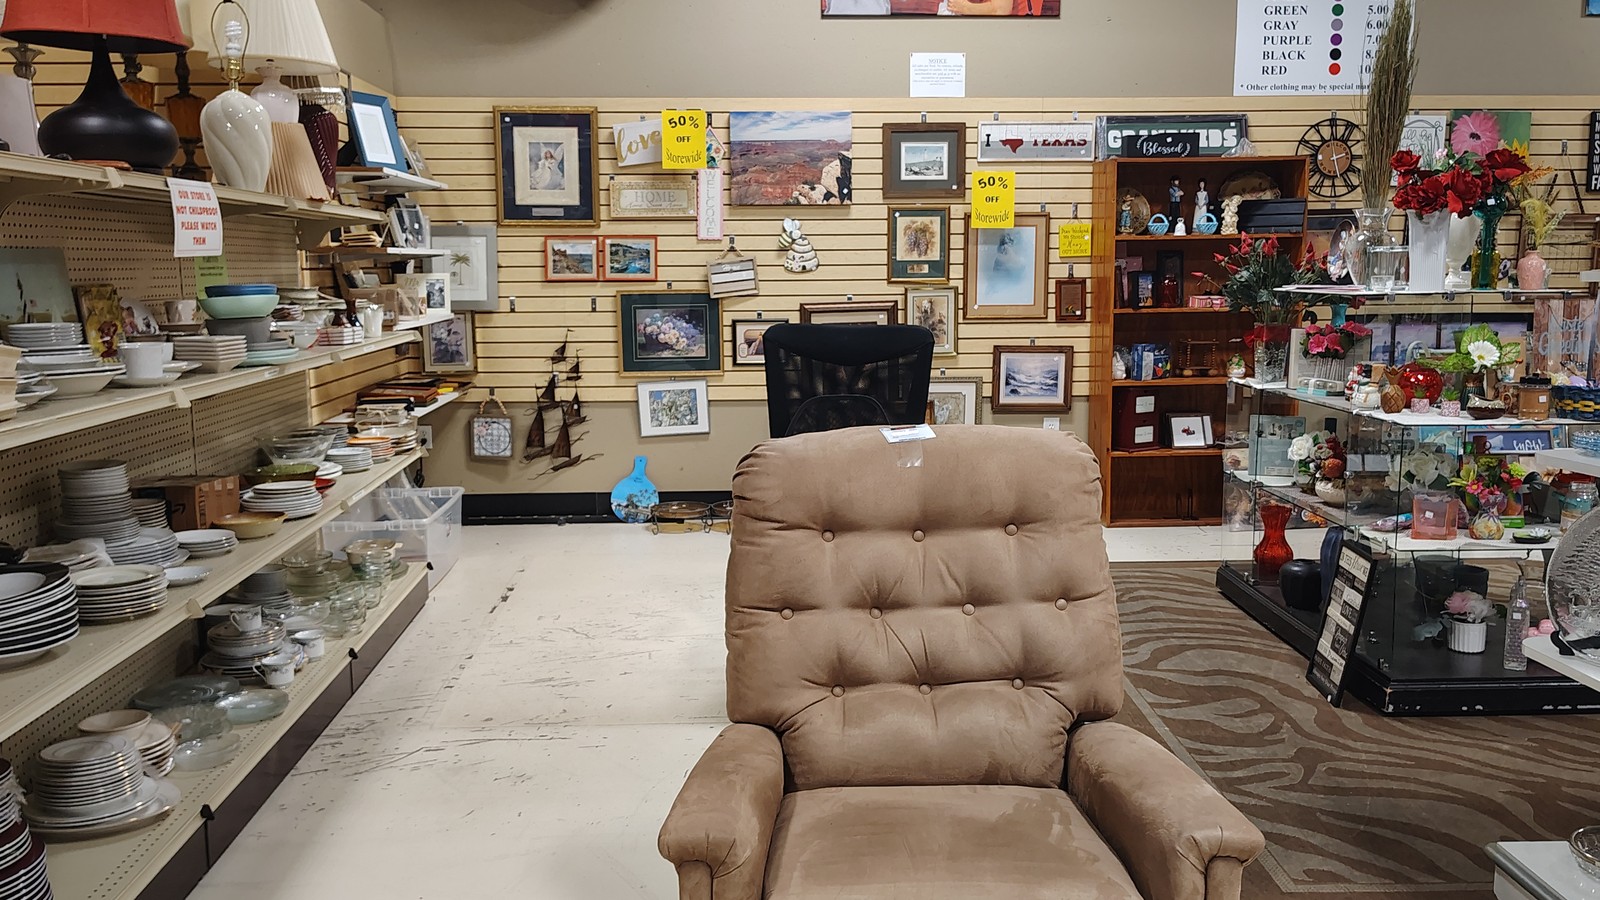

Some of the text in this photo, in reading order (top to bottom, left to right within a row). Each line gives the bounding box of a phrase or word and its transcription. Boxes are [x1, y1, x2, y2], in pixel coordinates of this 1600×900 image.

[1264, 5, 1389, 15] GREEN 5.00
[1263, 20, 1388, 31] GRAY 6.00
[1263, 35, 1381, 46] PURPLE 7.0
[1262, 50, 1306, 61] BLACK
[1261, 65, 1287, 76] RED
[1246, 83, 1269, 91] Other
[1270, 83, 1300, 92] clothing
[1319, 83, 1327, 91] be
[1329, 83, 1354, 92] special
[668, 115, 700, 129] 50%
[985, 133, 1088, 147] I TEXAS
[1143, 141, 1184, 156] Blessed
[665, 147, 702, 164] Storewide
[978, 176, 1009, 189] 50%
[178, 190, 189, 199] OUR
[190, 191, 204, 200] STORE
[634, 191, 677, 203] HOME
[704, 170, 717, 237] WELCOME
[176, 206, 218, 216] NOT CHILDPROOF
[974, 208, 1010, 224] Storewide
[181, 221, 217, 231] PLEASE WATCH
[193, 237, 207, 246] THEM
